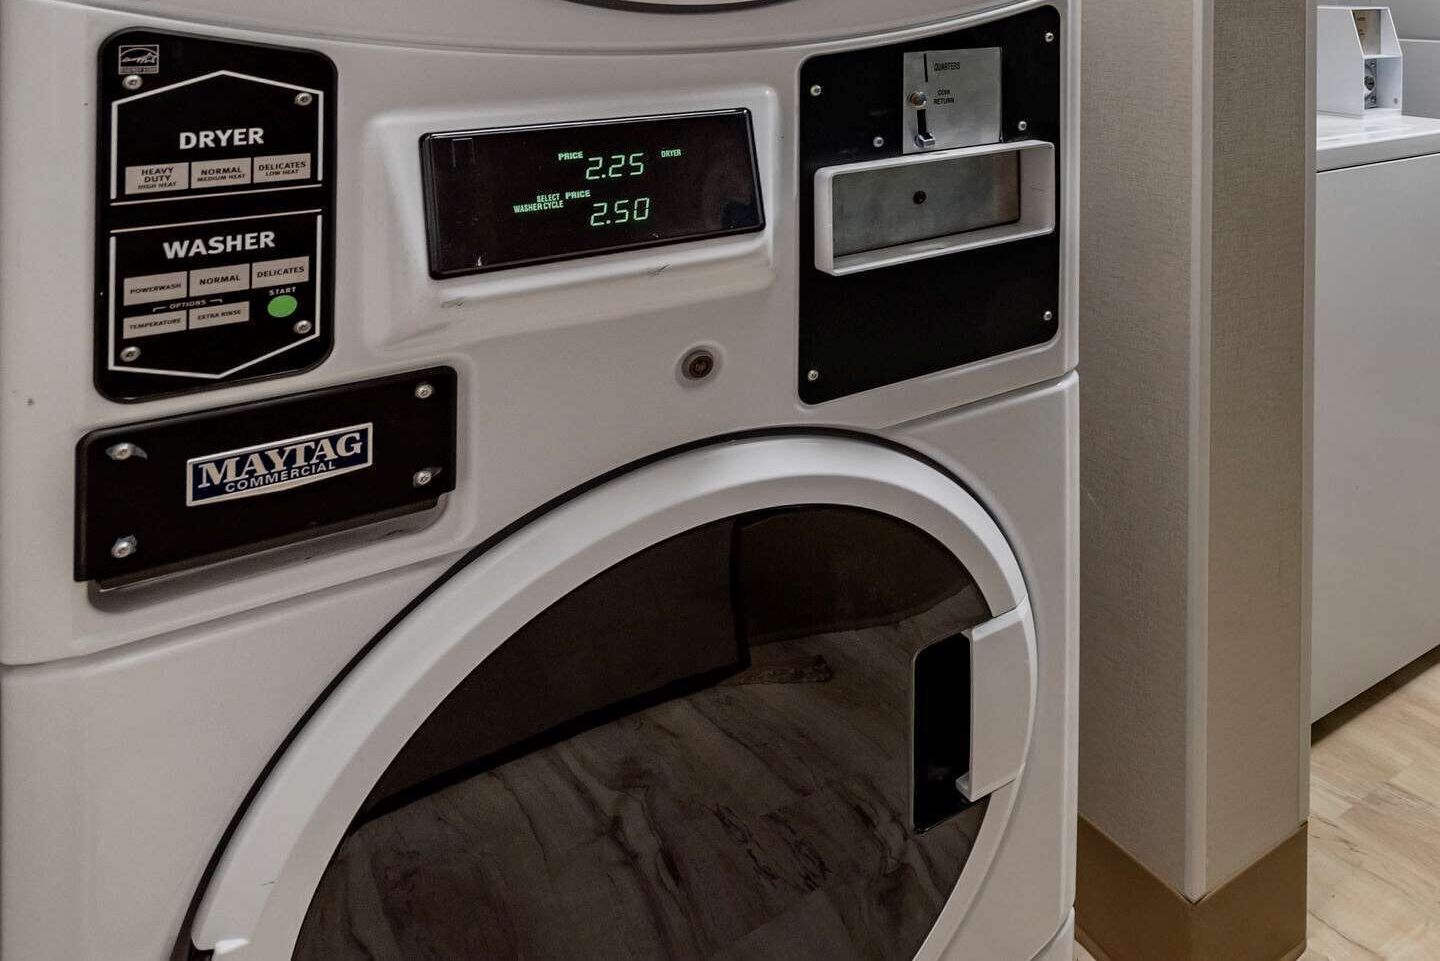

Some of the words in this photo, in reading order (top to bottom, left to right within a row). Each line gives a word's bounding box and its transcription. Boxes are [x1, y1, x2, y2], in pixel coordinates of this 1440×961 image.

[179, 127, 264, 150] DRYER
[258, 161, 306, 172] DELICATES
[558, 150, 584, 161] PRICE
[585, 152, 645, 181] 2.25
[660, 148, 682, 158] DRYER
[141, 166, 175, 176] HEAVY
[200, 166, 242, 176] NORMAL
[144, 174, 171, 184] DUTY
[197, 175, 227, 183] MEDIUM
[536, 193, 561, 203] SELECT
[565, 189, 591, 200] PRICE
[513, 202, 543, 214] WASHER
[543, 199, 565, 211] CYCLE
[589, 197, 650, 227] 2.50
[162, 230, 276, 260] WASHER
[257, 265, 305, 279] DELICATES
[199, 274, 241, 286] NORMAL
[130, 282, 181, 295] POWERWASH
[268, 286, 297, 296] START
[169, 299, 207, 310] OPTIONS
[197, 312, 220, 321] EXTRA
[220, 309, 242, 318] RINSE
[129, 318, 182, 330] TEMPERATURE
[198, 431, 363, 489] MAYTAG
[225, 460, 336, 493] COMMERCIAL
